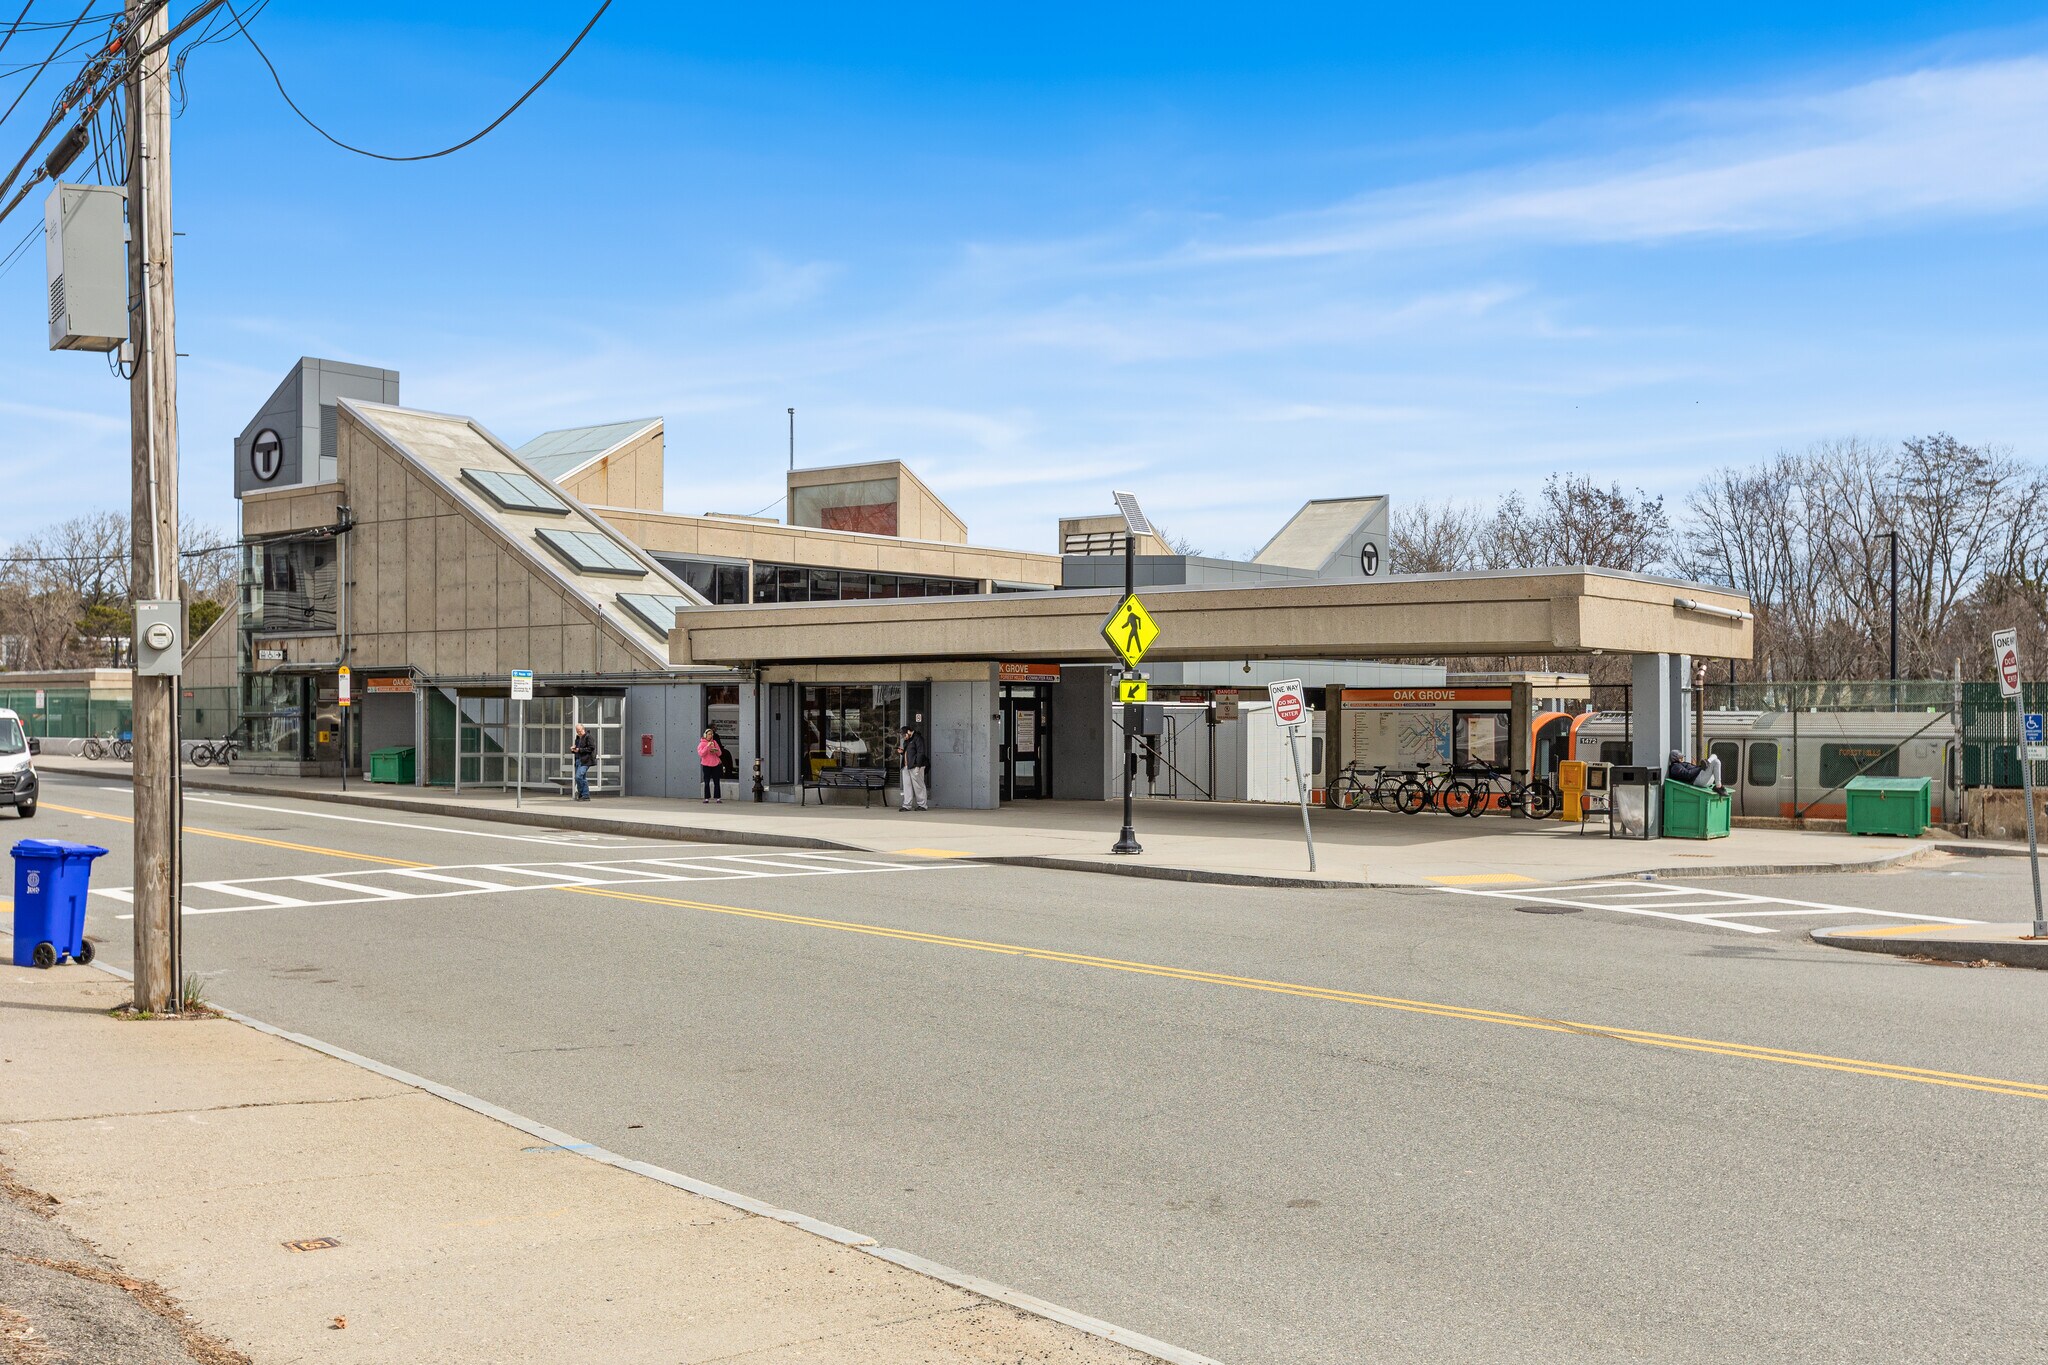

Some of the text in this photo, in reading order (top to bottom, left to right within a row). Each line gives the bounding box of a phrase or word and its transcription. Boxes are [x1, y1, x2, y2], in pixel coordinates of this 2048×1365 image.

[1996, 637, 2010, 648] ONE
[1005, 664, 1029, 673] GROVE
[1393, 690, 1456, 700] OAK GROVE
[1863, 749, 1881, 757] HILLS
